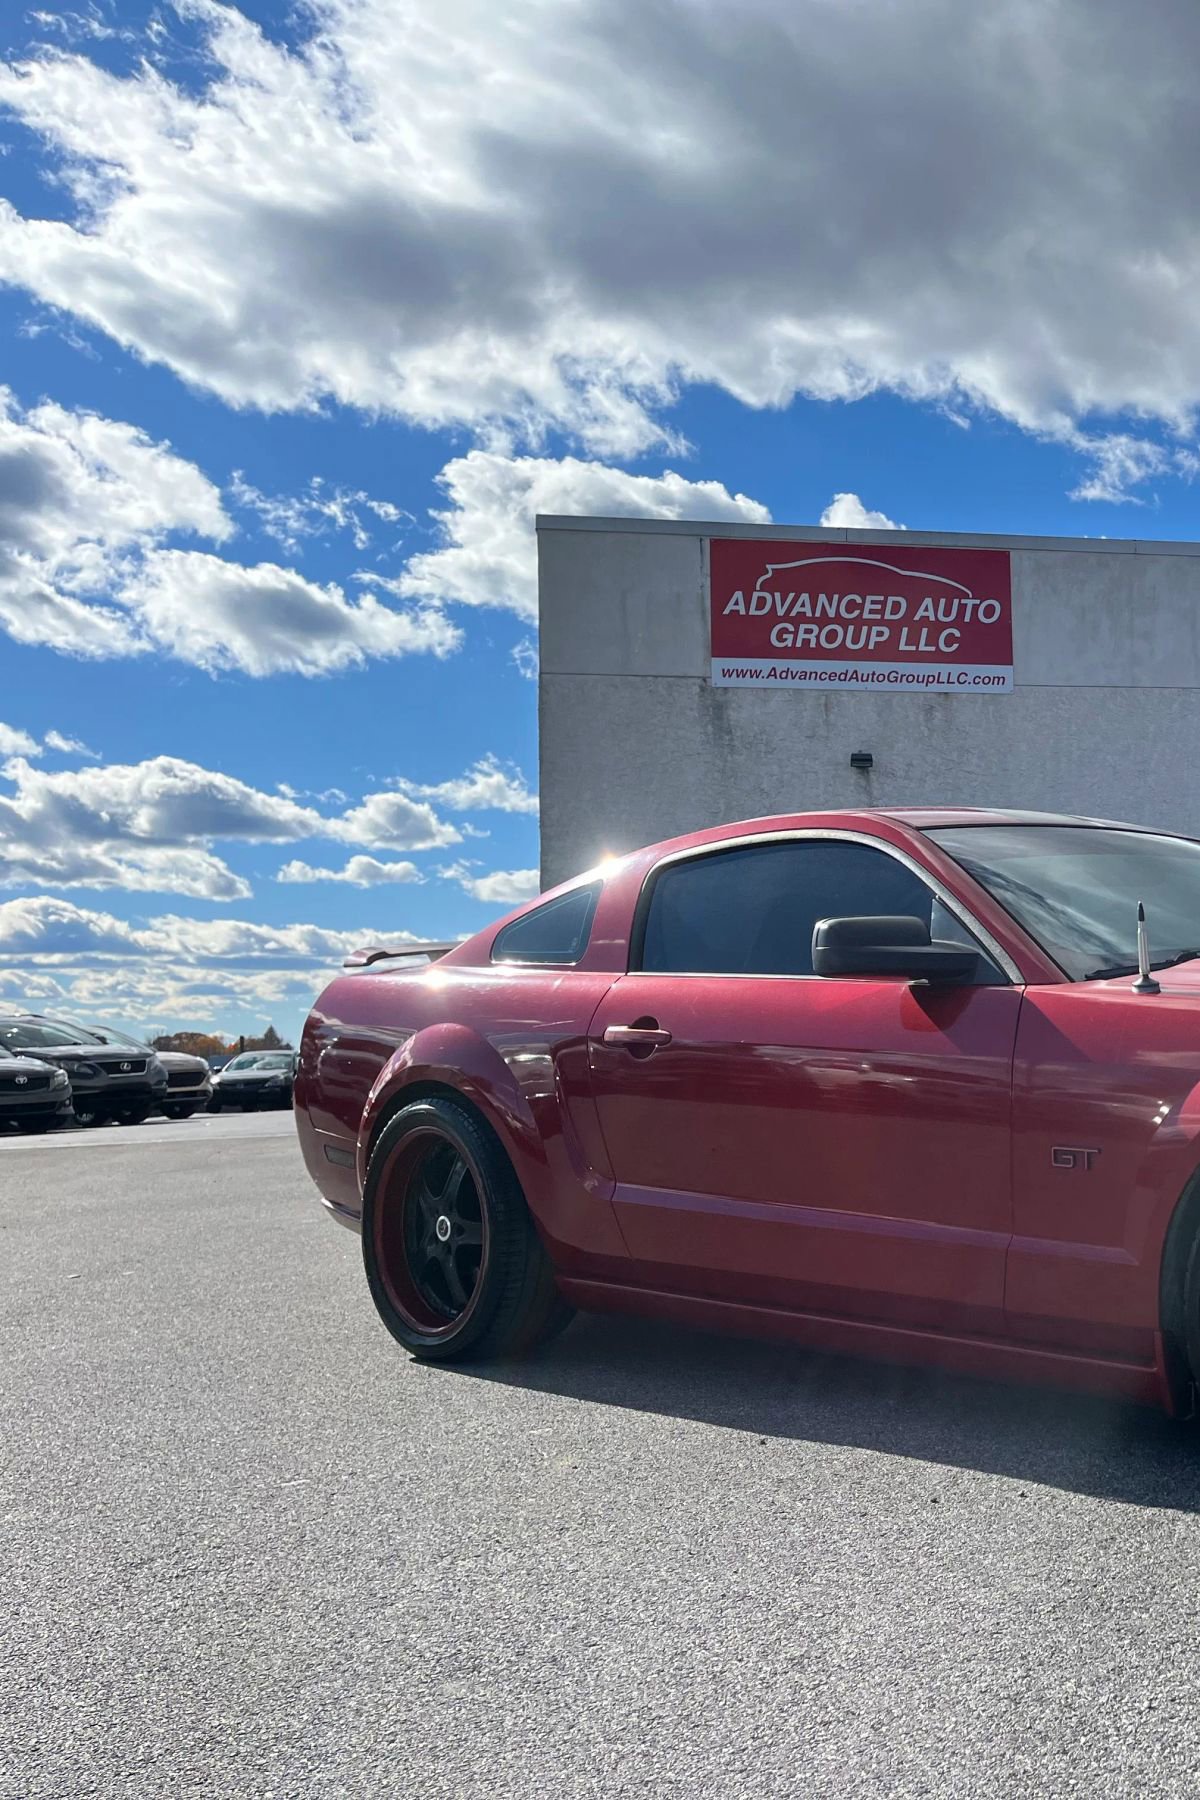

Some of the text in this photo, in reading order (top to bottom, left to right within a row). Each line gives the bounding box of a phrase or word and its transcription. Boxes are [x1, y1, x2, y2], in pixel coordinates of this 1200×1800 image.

[722, 590, 1002, 624] ADVANCED AUTO
[770, 622, 961, 653] GROUP LLC
[721, 666, 1006, 687] www.AdvancedAutoGroupLLC.com
[1050, 1145, 1099, 1170] GT
